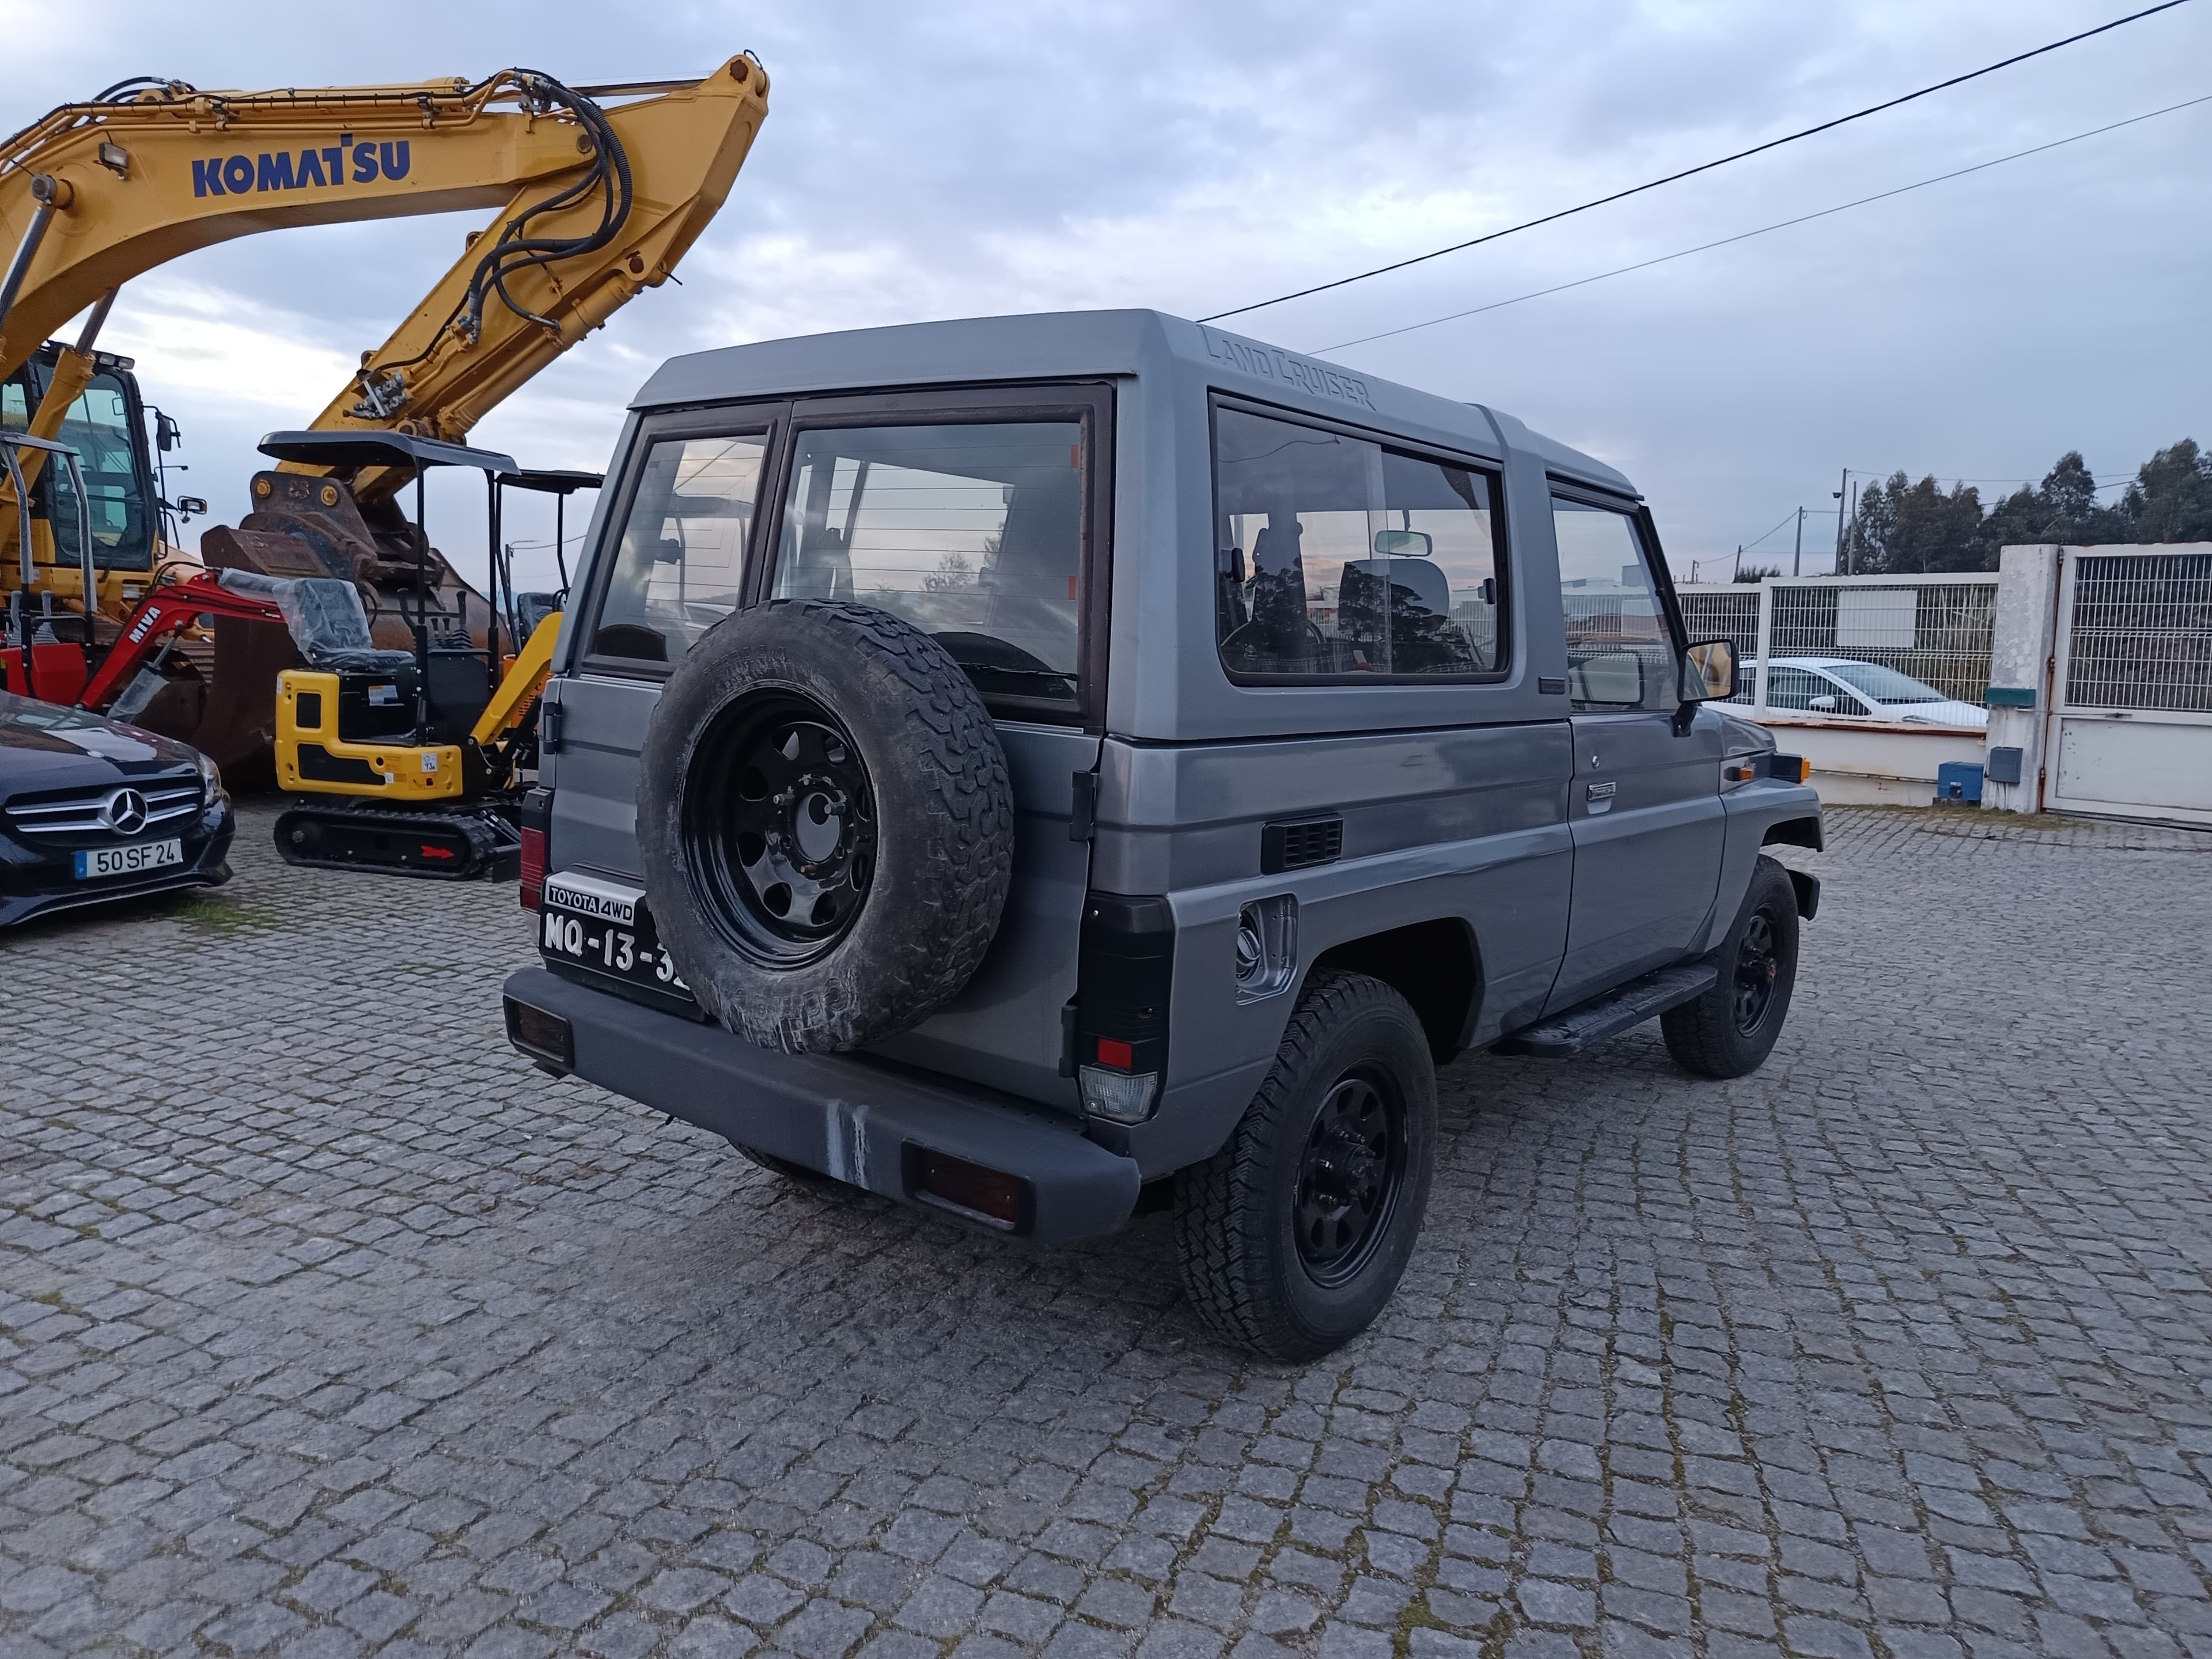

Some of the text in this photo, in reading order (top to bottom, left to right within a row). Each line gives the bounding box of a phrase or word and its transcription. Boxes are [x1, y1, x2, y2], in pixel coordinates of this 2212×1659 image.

[192, 133, 410, 197] KOMATSU
[1196, 324, 1377, 411] LAND CRUISER
[128, 607, 161, 644] MIVA
[97, 851, 123, 873] 50
[126, 846, 152, 869] SF
[156, 842, 175, 865] 24
[551, 887, 632, 921] TOYOTA 4WD
[545, 912, 691, 991] MQ-13-3
